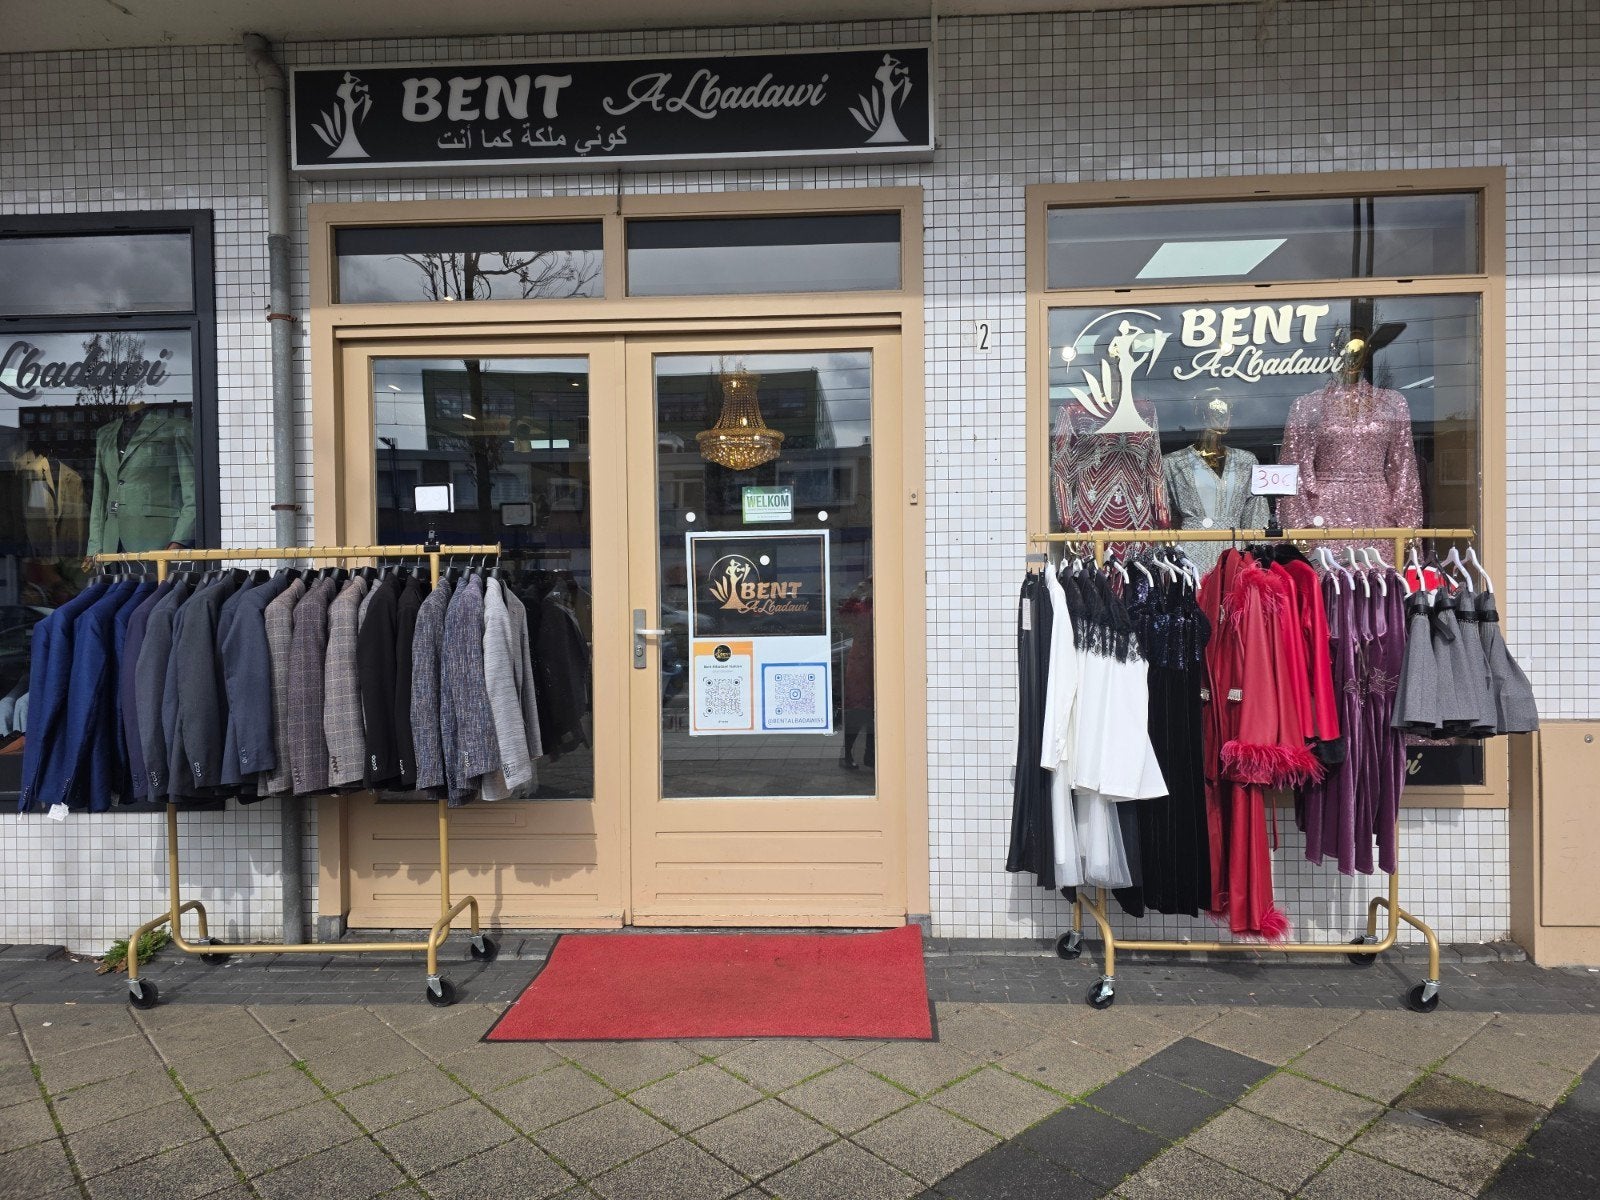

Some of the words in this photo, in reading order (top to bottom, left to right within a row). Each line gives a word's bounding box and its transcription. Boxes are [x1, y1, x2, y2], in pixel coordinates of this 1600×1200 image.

[401, 74, 573, 123] BENT
[437, 124, 473, 149] أنت
[481, 128, 514, 148] كما
[521, 122, 567, 147] ملكة
[574, 125, 628, 157] كوني
[979, 323, 989, 350] 2
[1181, 303, 1330, 348] BENT
[746, 494, 789, 508] WELKOM
[741, 581, 802, 600] BENT
